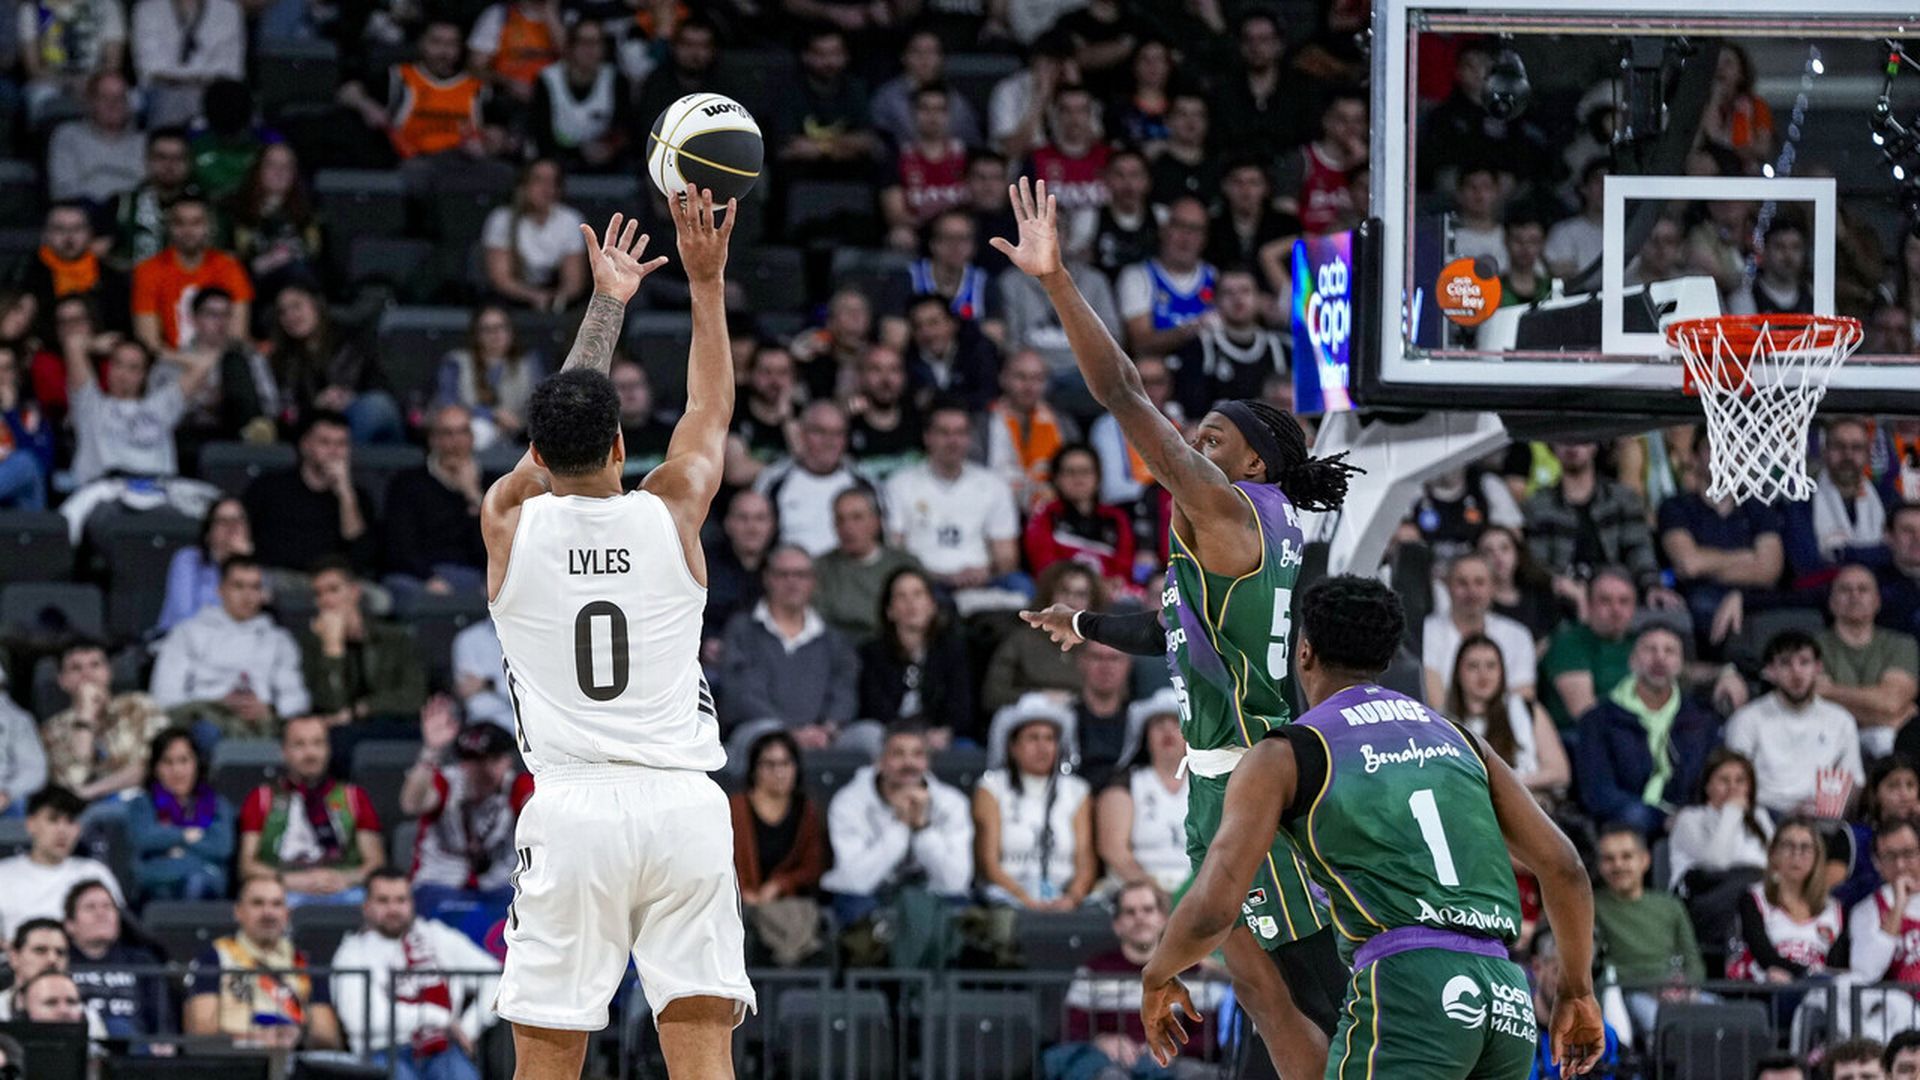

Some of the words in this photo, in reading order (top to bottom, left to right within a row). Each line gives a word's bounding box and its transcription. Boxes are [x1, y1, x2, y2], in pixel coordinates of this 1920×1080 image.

[1318, 255, 1348, 298] acb
[1446, 283, 1481, 297] Copa
[568, 548, 631, 575] LYLES
[1267, 587, 1292, 680] 5
[575, 600, 629, 702] 0
[1340, 699, 1431, 726] AUDIGE
[1408, 789, 1460, 886] 1
[1492, 1000, 1521, 1019] DEL
[1522, 1007, 1537, 1029] SO
[1491, 1016, 1537, 1044] MÁLAG
